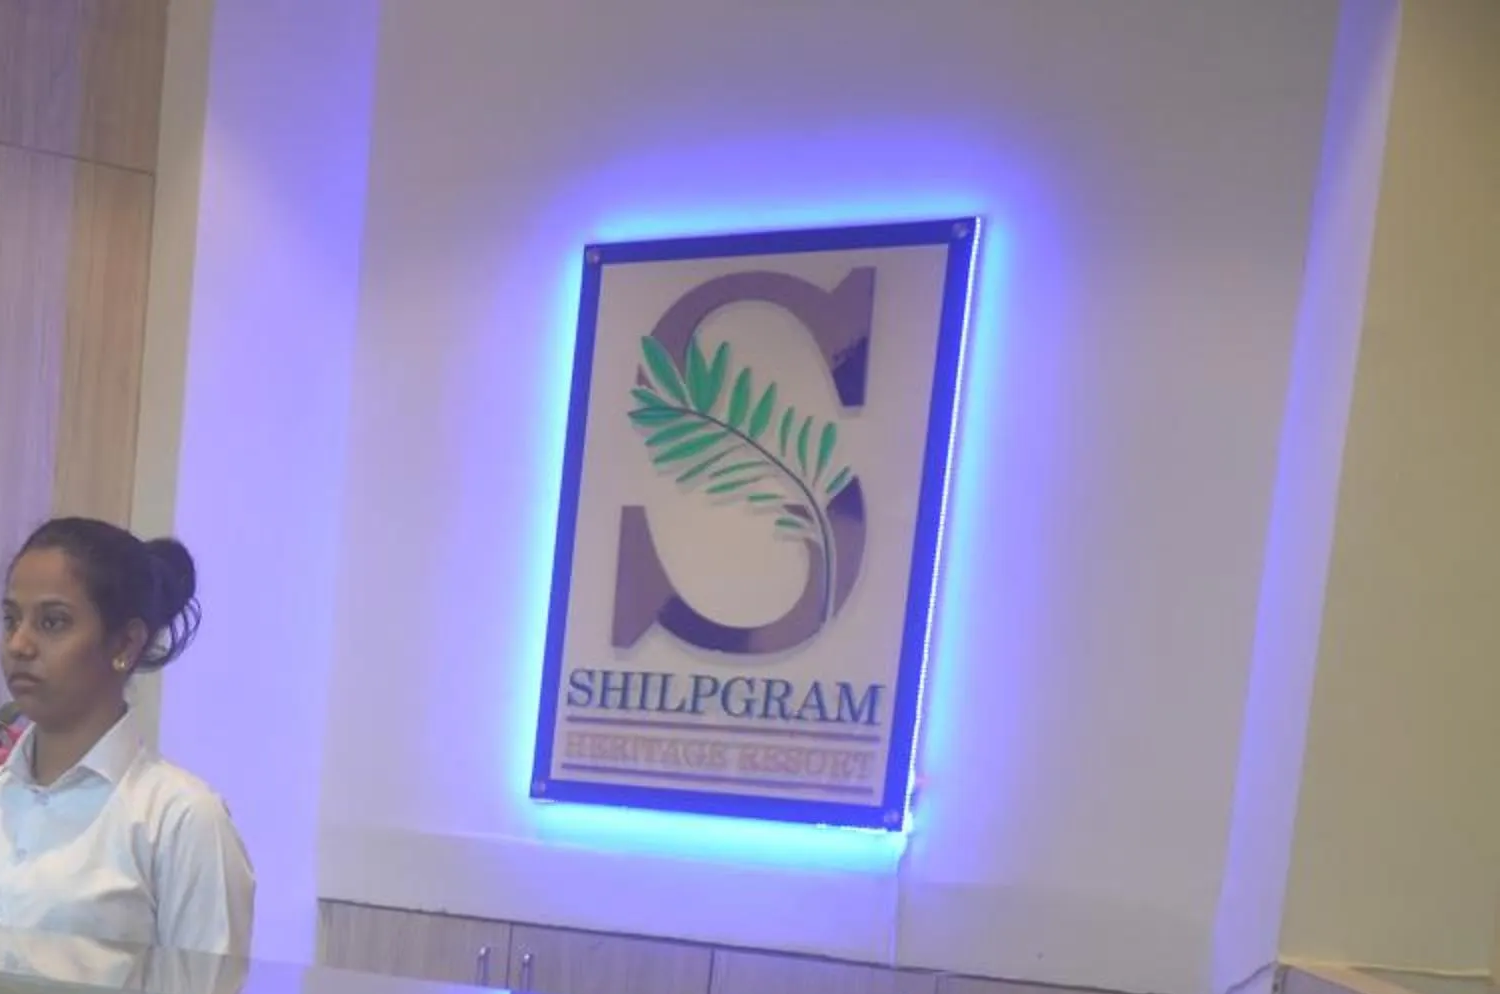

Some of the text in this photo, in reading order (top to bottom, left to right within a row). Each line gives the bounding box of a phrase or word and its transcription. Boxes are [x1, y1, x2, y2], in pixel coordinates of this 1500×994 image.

[566, 668, 885, 726] SHILPGRAM
[564, 731, 876, 780] HERITAGE RESORT
